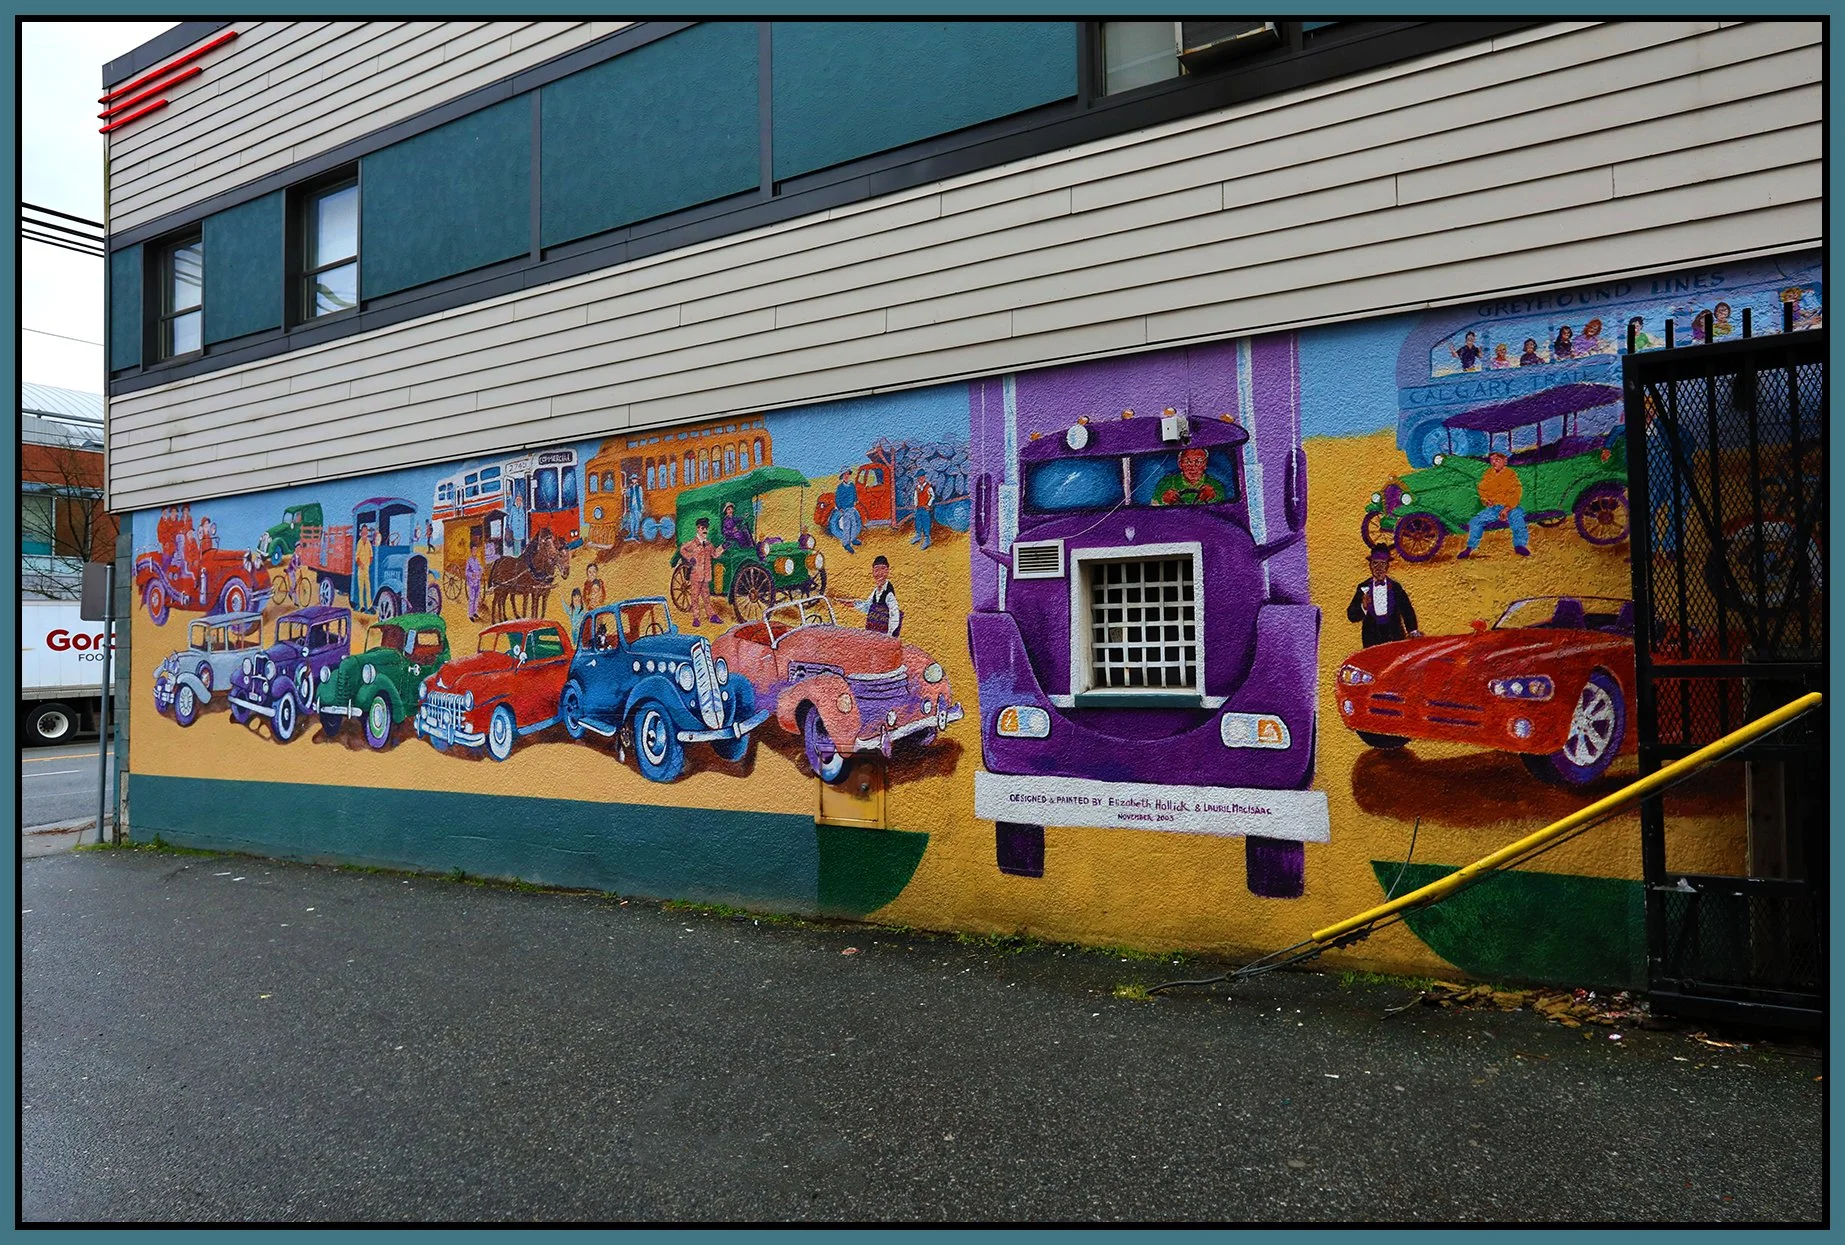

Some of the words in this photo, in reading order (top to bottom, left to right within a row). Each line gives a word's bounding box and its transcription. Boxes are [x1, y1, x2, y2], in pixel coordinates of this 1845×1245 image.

[1477, 282, 1632, 318] GREYHOUND
[1650, 271, 1726, 295] LINES
[1408, 378, 1514, 404] CALGARY
[46, 629, 116, 652] Gor
[1009, 793, 1047, 804] DESIGNED
[1056, 796, 1090, 805] PAINTED
[1092, 797, 1103, 807] BY
[1108, 797, 1152, 809] Elizabeth
[1155, 799, 1191, 812] Hollick
[1194, 803, 1201, 813] &
